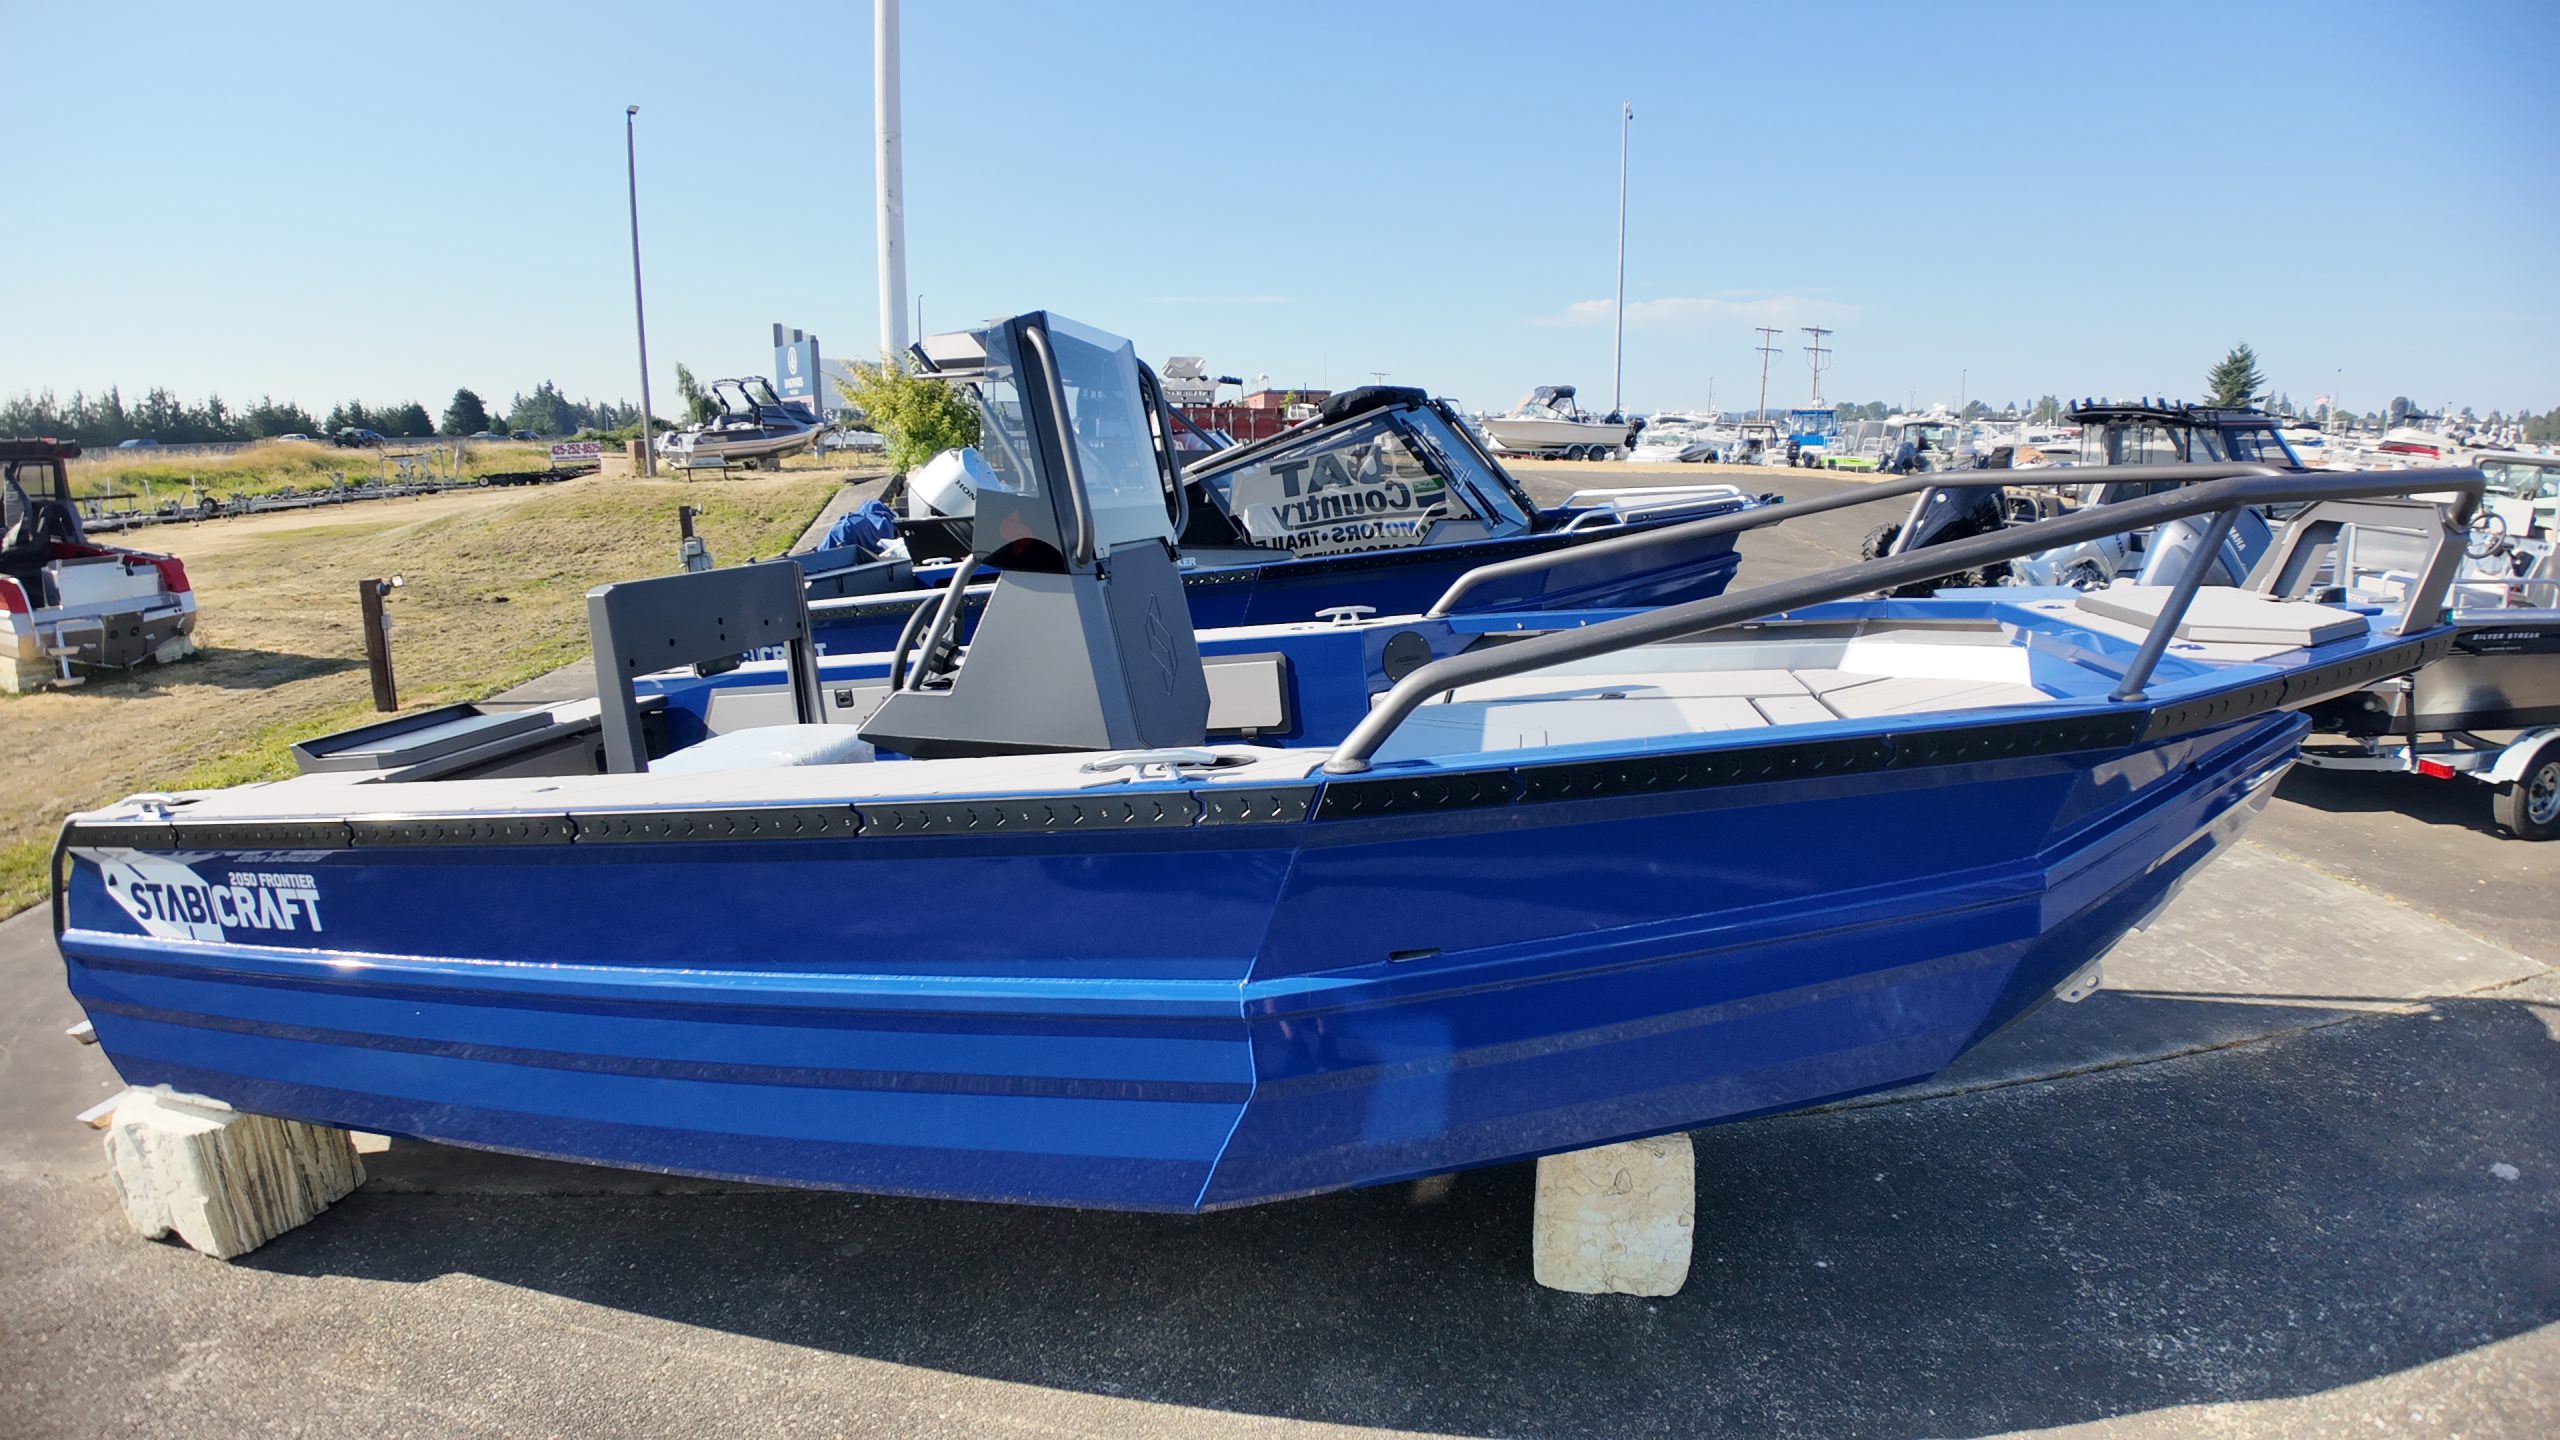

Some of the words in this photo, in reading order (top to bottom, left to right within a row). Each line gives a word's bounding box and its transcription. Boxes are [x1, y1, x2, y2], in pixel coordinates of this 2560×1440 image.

[955, 479, 976, 501] HON
[2472, 632, 2505, 641] SILVER
[228, 871, 258, 888] 2050
[258, 872, 317, 889] FRONTIER
[130, 882, 323, 932] STABICRAFT
